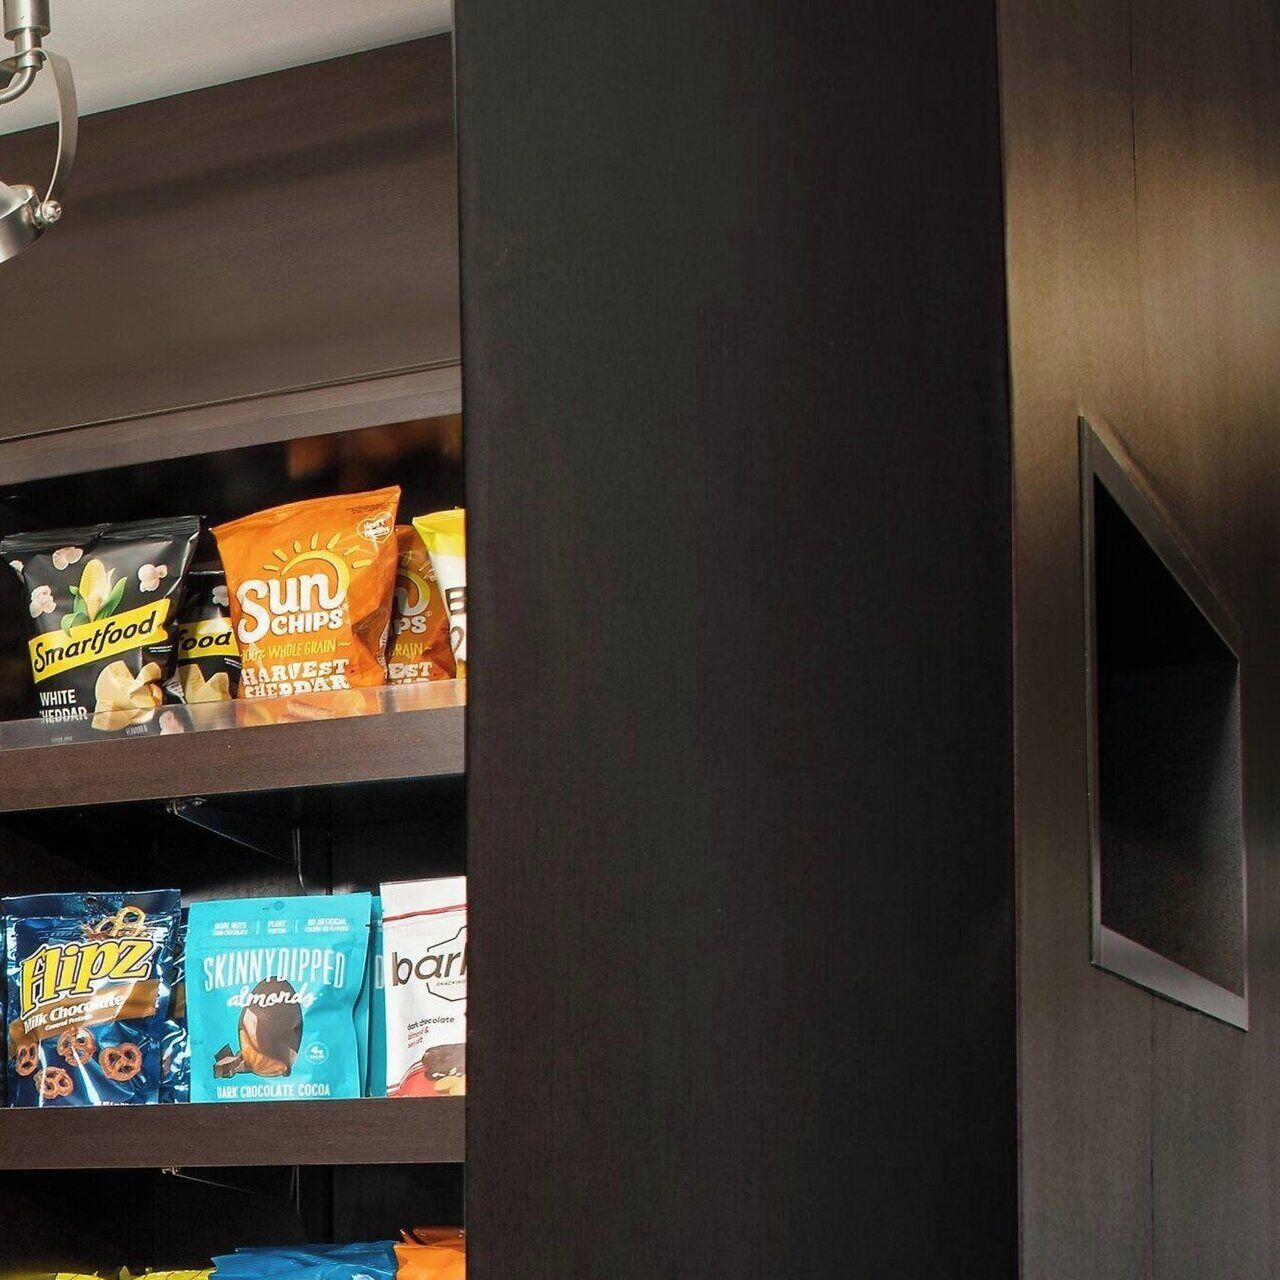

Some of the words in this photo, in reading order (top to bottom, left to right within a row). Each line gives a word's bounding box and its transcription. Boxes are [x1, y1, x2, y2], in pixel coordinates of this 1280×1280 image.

[237, 574, 348, 645] Sun
[271, 611, 343, 636] CHIPS
[34, 611, 156, 673] Smartfood
[268, 642, 305, 659] WHOLE
[305, 639, 338, 654] GRAIN
[241, 659, 349, 685] HARVEST
[40, 689, 76, 707] WHITE
[244, 675, 349, 698] CHEDDAR
[227, 981, 317, 1009] almonds
[217, 1085, 239, 1098] DARK
[240, 1083, 295, 1099] CHOCOLATE
[297, 1082, 331, 1096] COCOA
